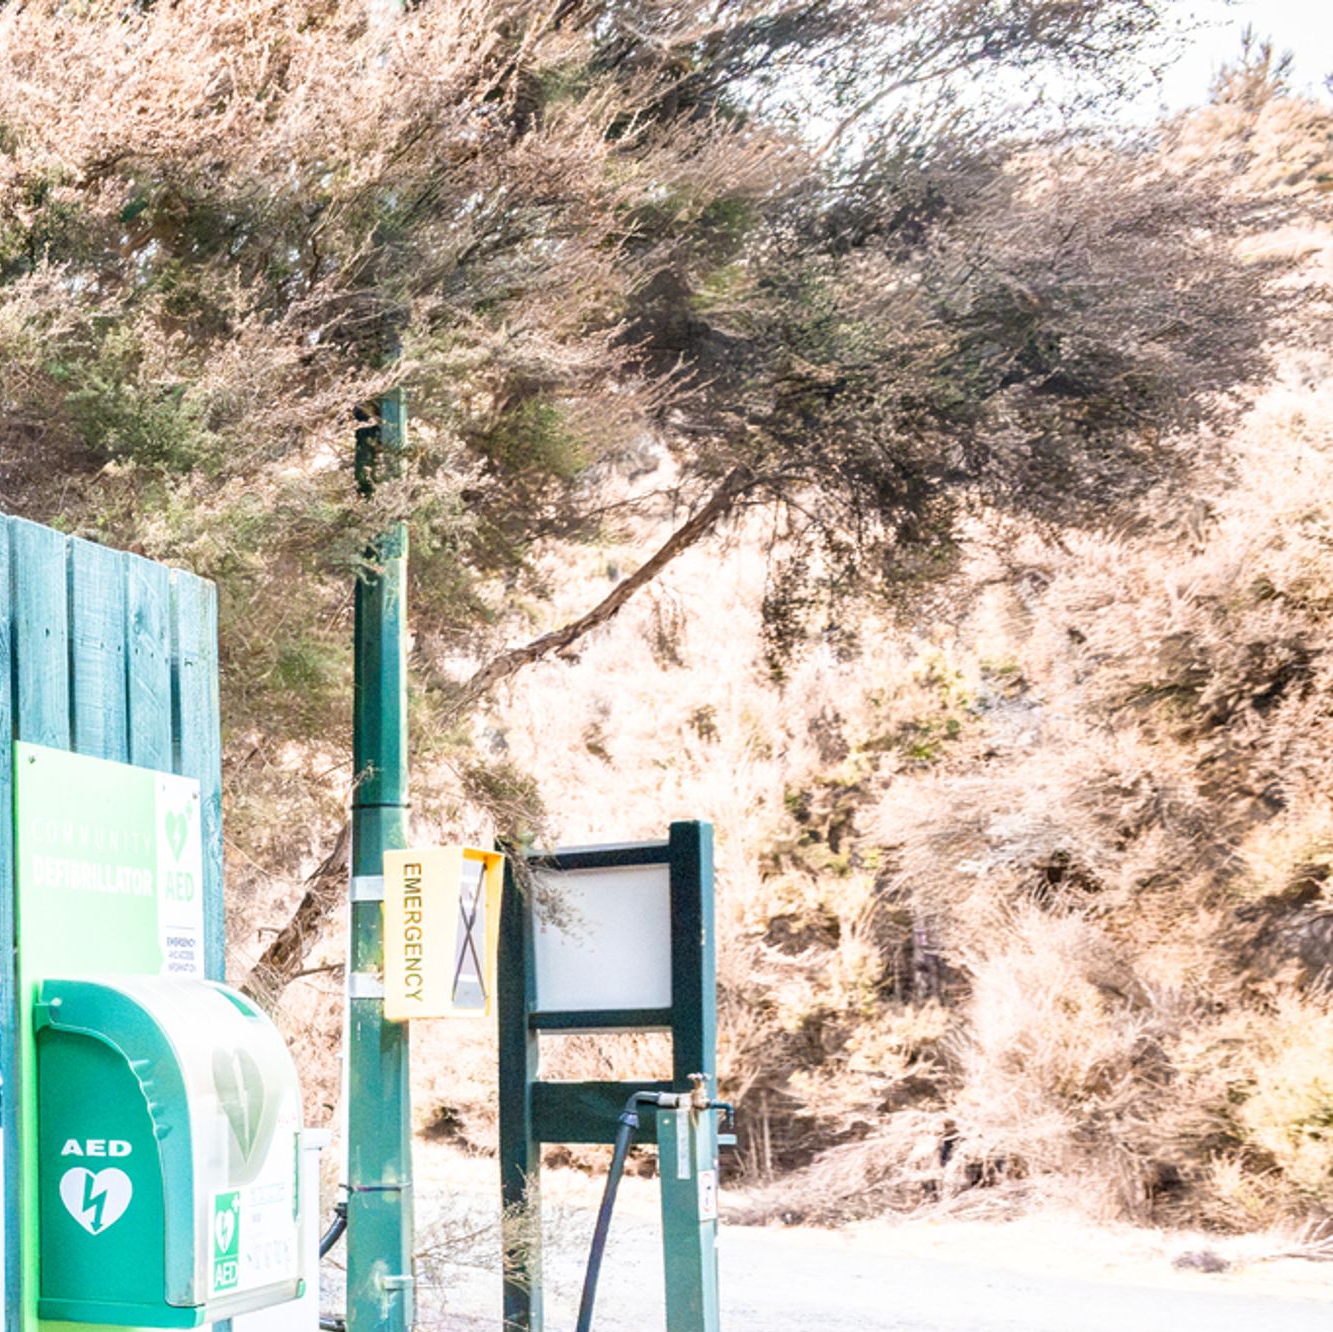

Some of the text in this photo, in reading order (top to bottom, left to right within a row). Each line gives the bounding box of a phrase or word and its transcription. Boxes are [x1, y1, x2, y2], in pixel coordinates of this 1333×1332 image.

[32, 817, 151, 855] COMMUNITY
[33, 854, 153, 896] DEFIBRILLATOR
[165, 870, 195, 903] AED
[403, 862, 423, 1002] EMERGENCY
[60, 1138, 133, 1157] AED
[213, 1261, 237, 1288] AED
